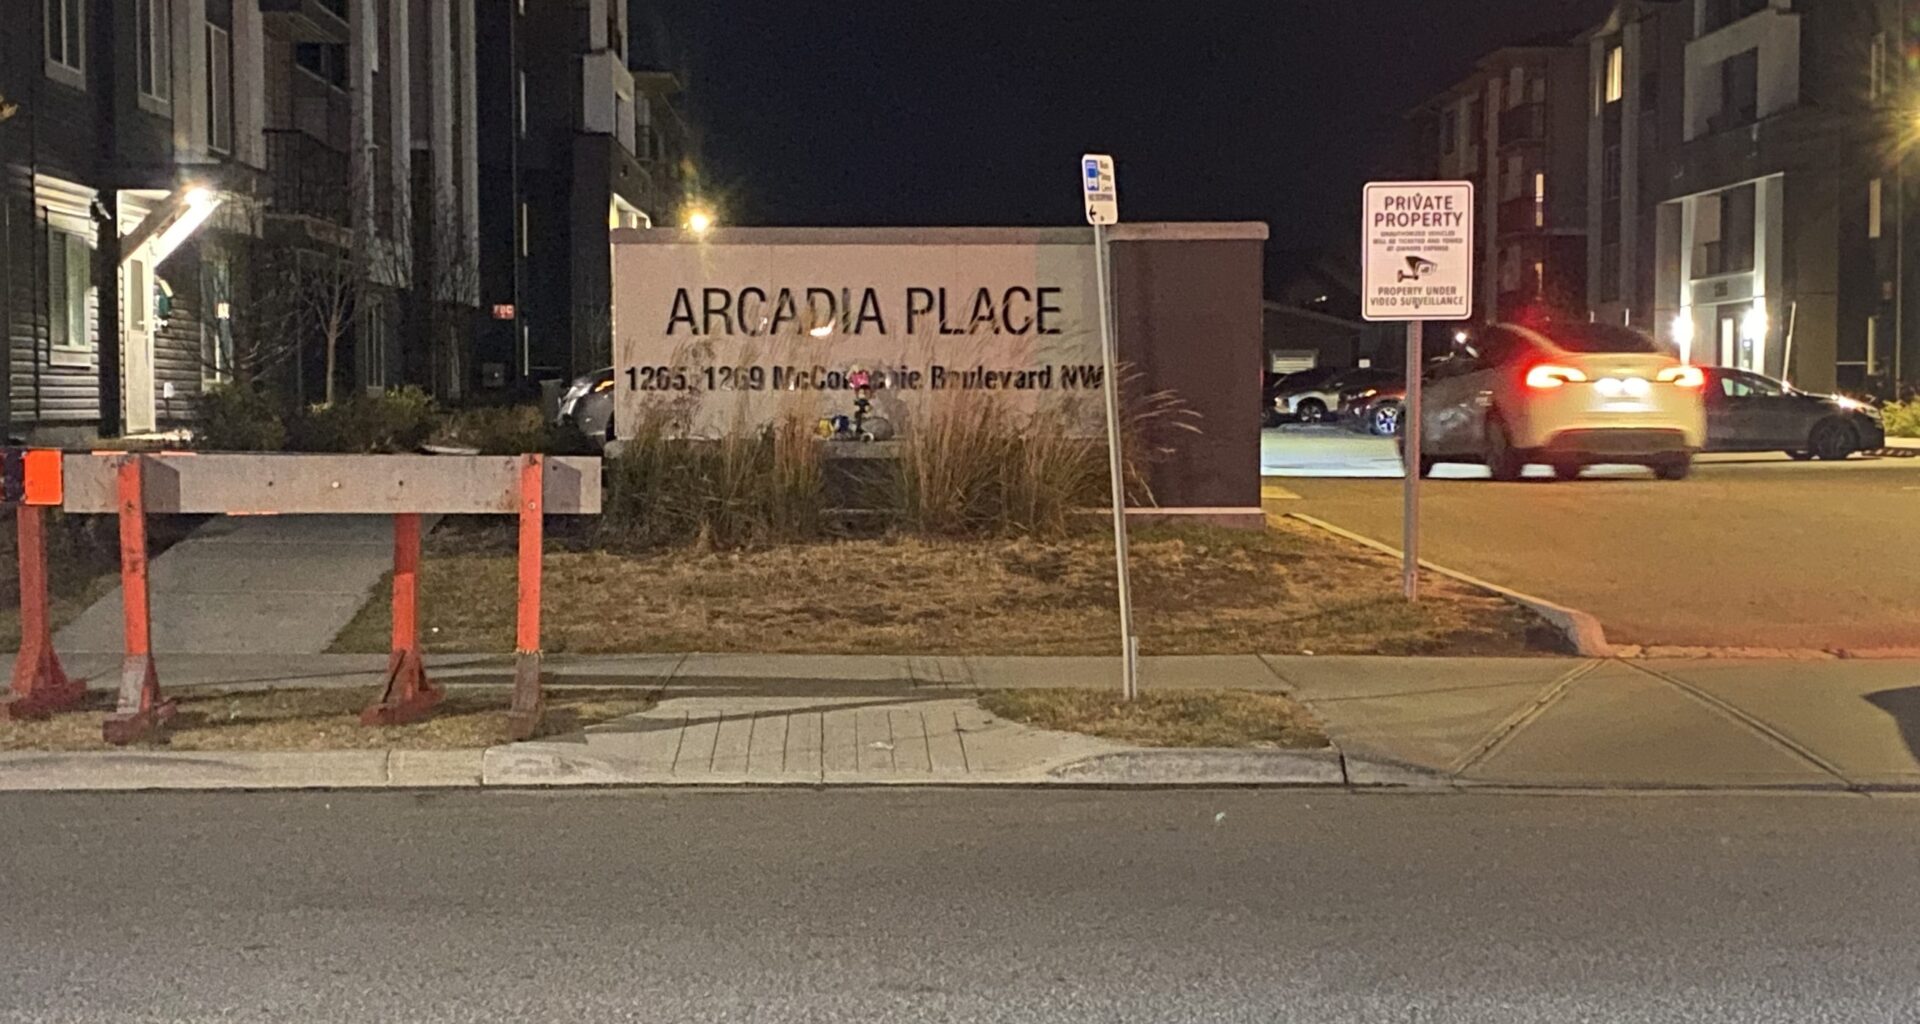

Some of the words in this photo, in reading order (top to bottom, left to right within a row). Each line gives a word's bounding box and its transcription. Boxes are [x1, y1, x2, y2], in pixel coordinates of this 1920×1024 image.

[1384, 195, 1453, 211] PRIVATE
[1374, 212, 1463, 227] PROPERTY
[1377, 286, 1423, 296] PROPERTY
[1426, 286, 1457, 295] UNDER
[1370, 297, 1397, 306] VIDEO
[1400, 296, 1464, 306] SURVEILLANCE
[666, 287, 886, 336] ARCADIA
[906, 286, 1063, 335] PLACE
[703, 365, 766, 392] 1269
[1061, 364, 1104, 390] NW
